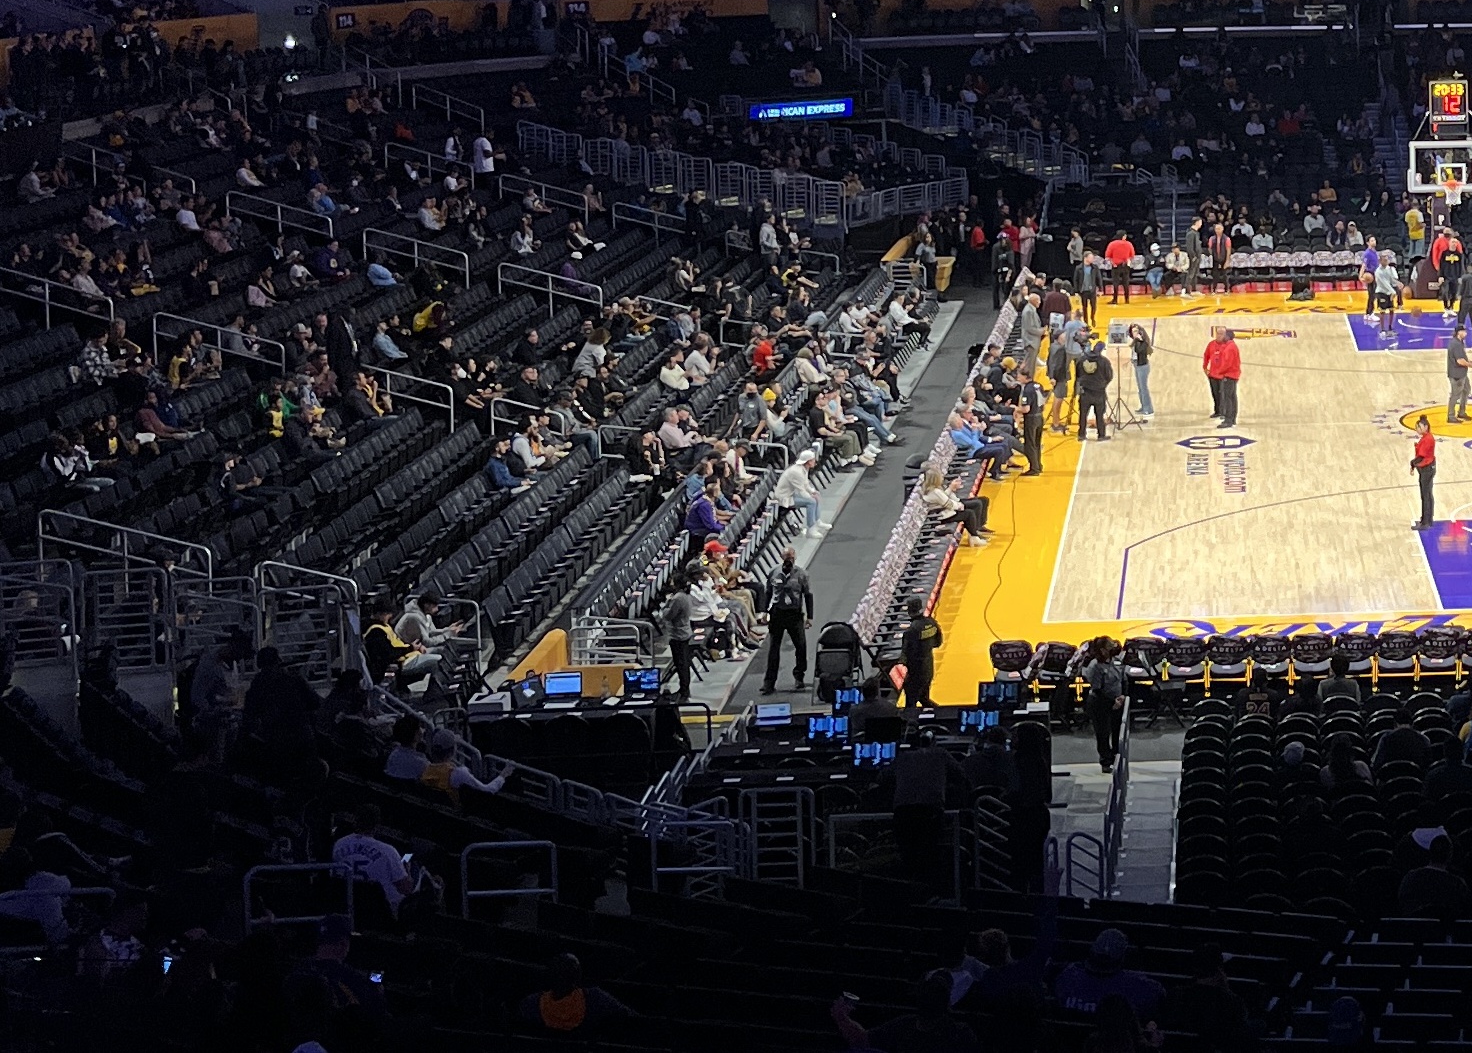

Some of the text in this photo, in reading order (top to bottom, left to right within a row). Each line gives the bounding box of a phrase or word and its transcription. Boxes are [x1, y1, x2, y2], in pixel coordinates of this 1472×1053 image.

[1433, 83, 1465, 97] 20:33
[807, 103, 846, 116] EXPRESS
[1444, 95, 1461, 114] 12
